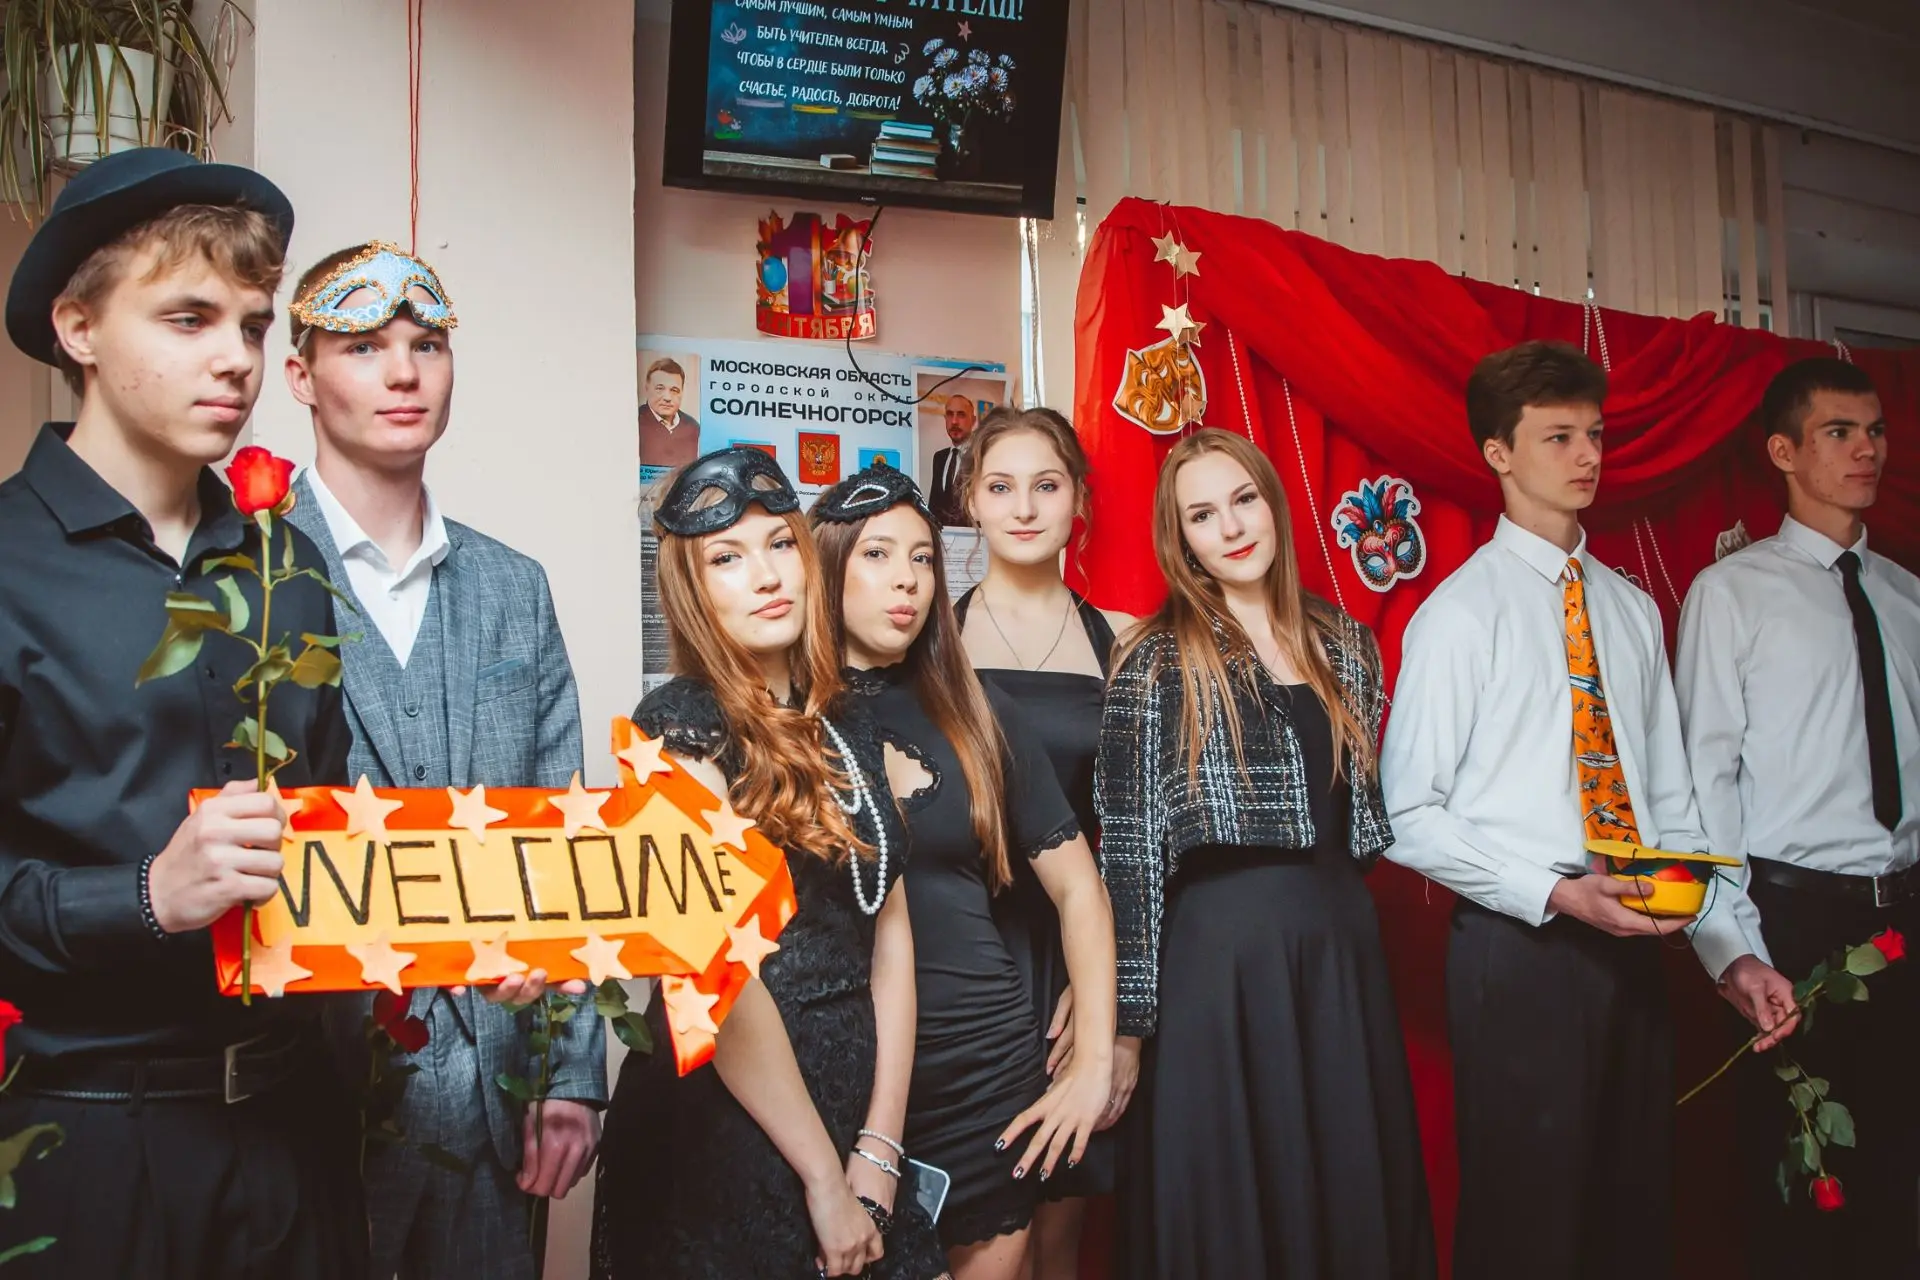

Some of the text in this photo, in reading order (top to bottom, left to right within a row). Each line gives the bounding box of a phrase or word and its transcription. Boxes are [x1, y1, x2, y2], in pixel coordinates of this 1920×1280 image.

[735, 0, 913, 29] САМЫМ ЛУЧШИМ, САМЫМ УМНЫМ
[757, 25, 889, 55] БЫТЬ УЧИТЕЛЕМ ВСЕГДА.
[737, 51, 906, 84] ЧТОБЫ В СЕРДЦЕ БЫЛИ ТОЛЬКО
[739, 80, 901, 111] СЧАСТЬЕ, РАДОСТЬ, ДОБРОТА!
[757, 311, 875, 340] НТЯБРЯ
[710, 359, 912, 386] МОСКОВСКАЯ ОБЛАСТЬ
[710, 381, 829, 398] ГОРОДСКОЙ
[710, 397, 912, 428] СОЛНЕЧНОГОРСК
[278, 832, 737, 928] WELCOME
